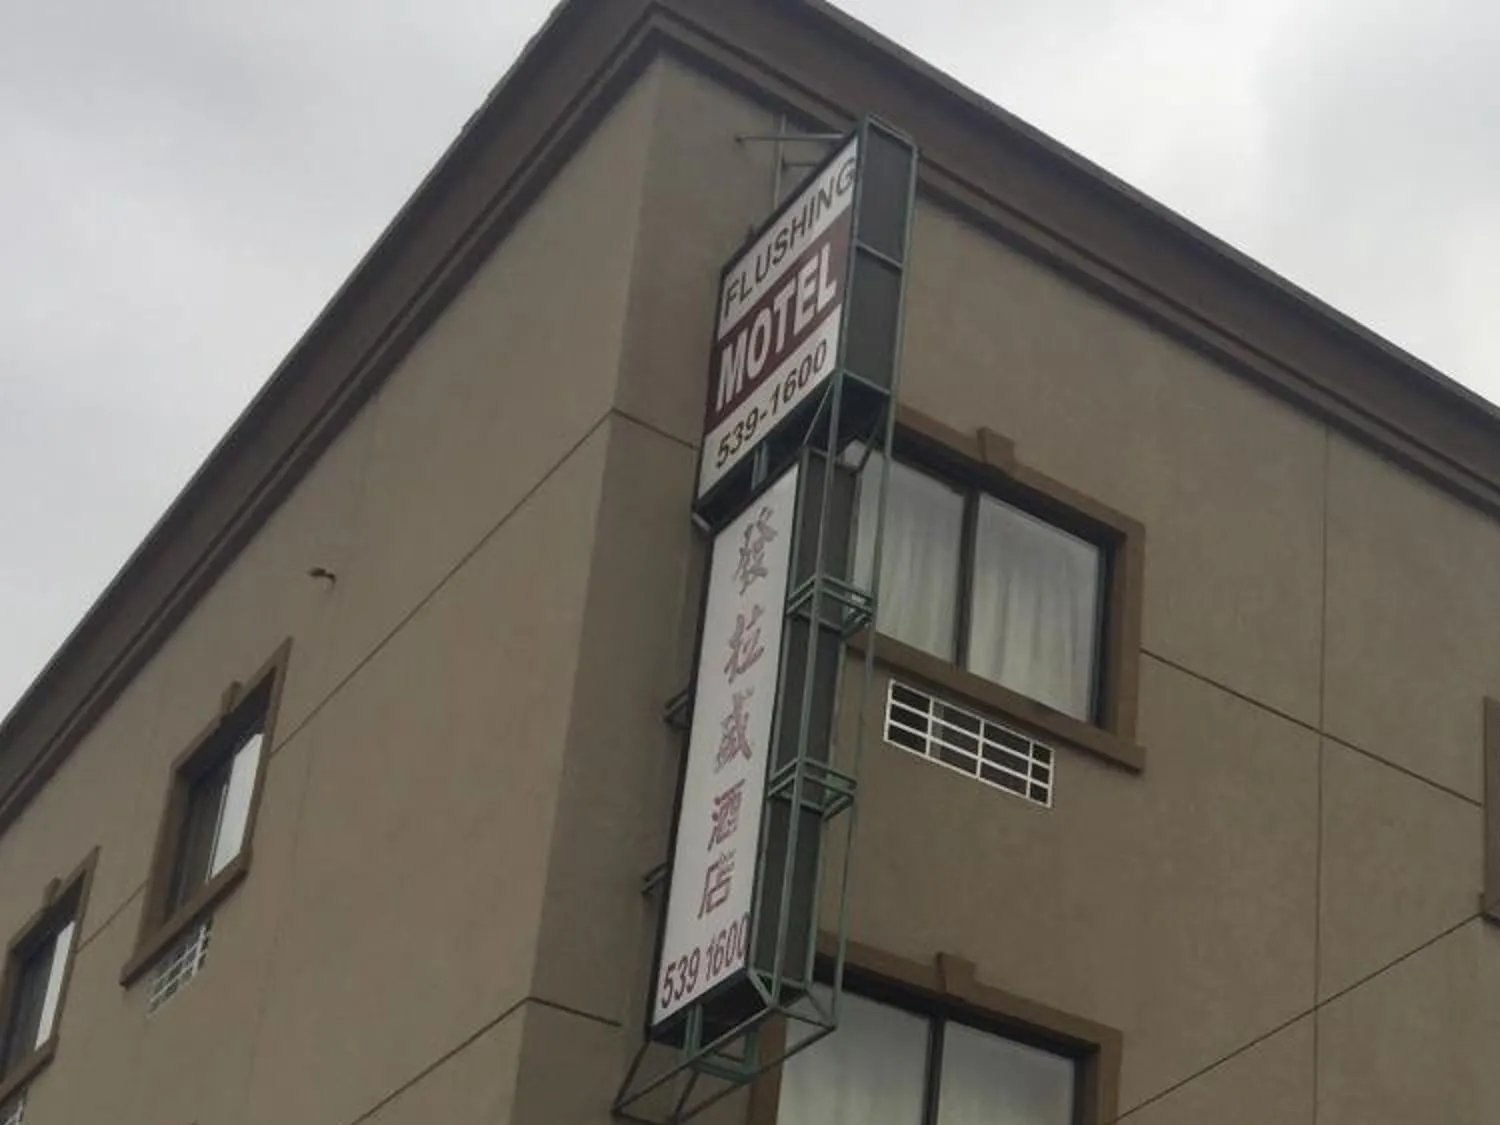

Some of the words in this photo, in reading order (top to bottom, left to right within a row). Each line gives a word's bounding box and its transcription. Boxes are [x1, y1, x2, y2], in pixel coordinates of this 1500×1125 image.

[724, 157, 856, 318] FLUSHING
[715, 242, 837, 413] MOTEL
[716, 339, 828, 469] 539-1600
[661, 946, 700, 1009] 539
[705, 911, 750, 981] 1600
